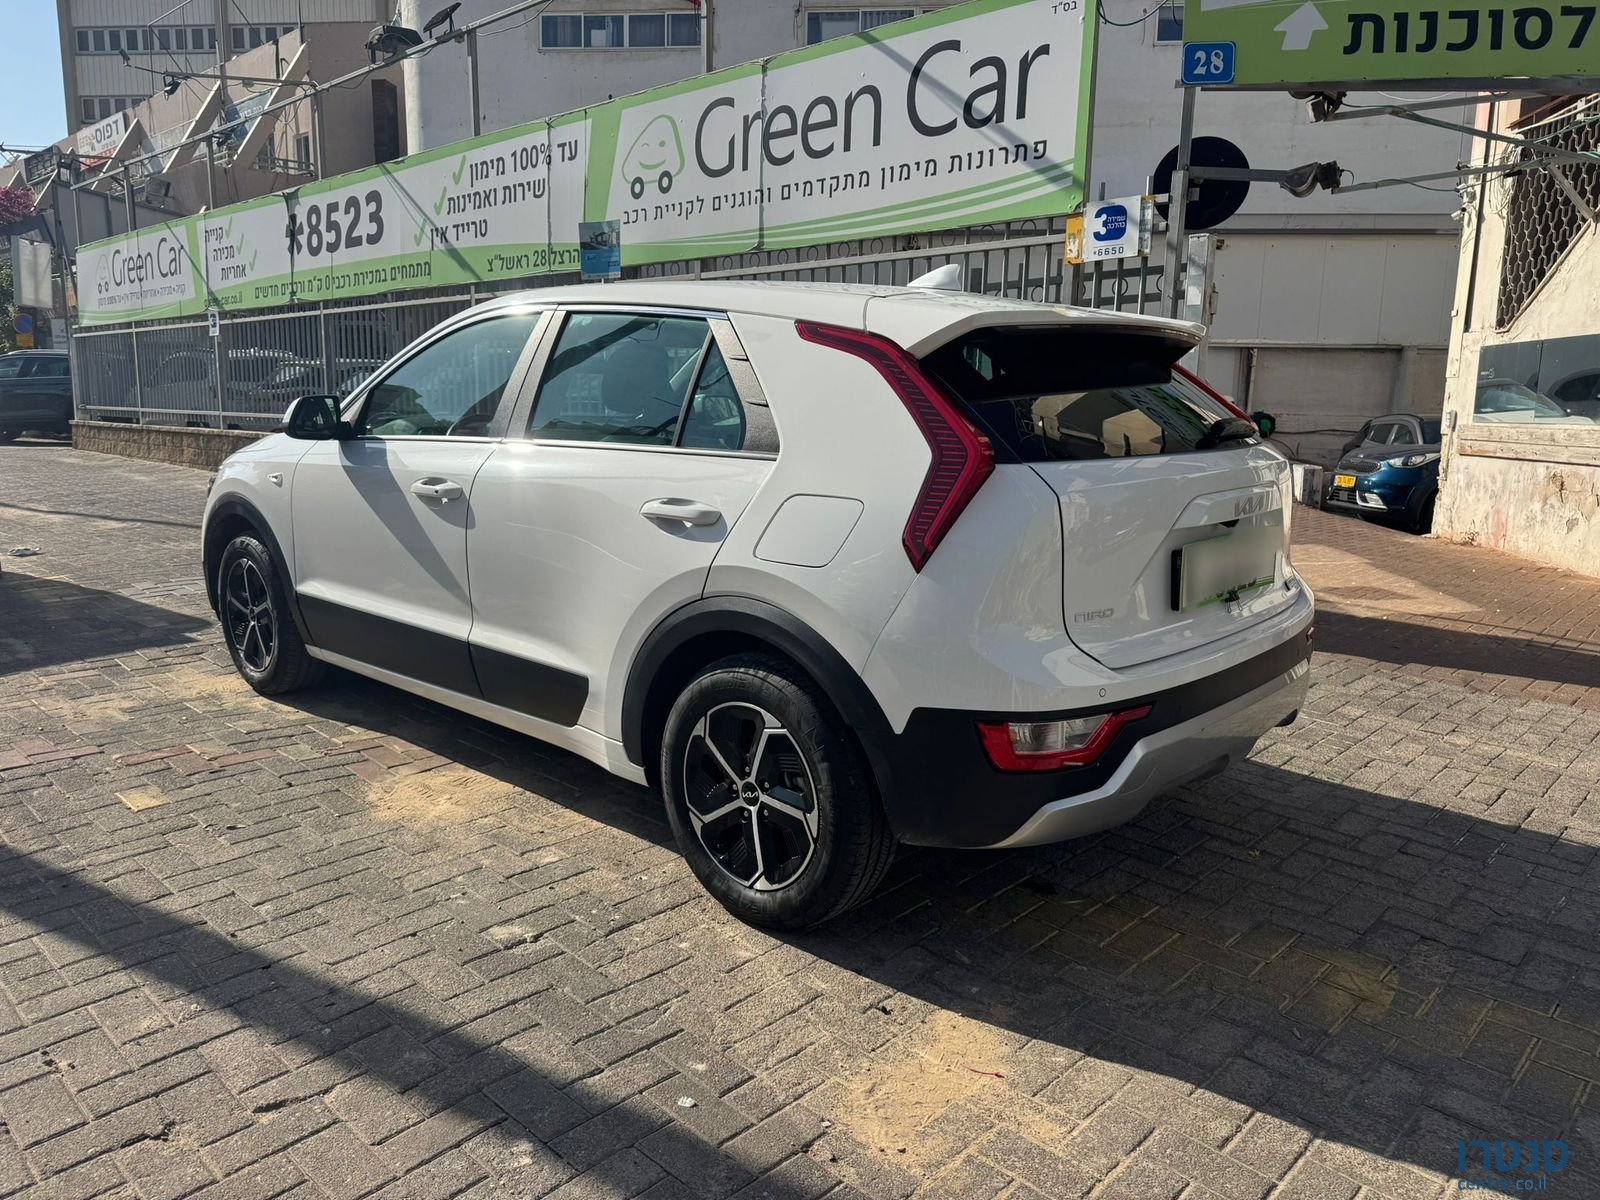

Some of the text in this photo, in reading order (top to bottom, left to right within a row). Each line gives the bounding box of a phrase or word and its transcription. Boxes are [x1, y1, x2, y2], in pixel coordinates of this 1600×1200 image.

[1343, 6, 1597, 55] לסוכנות
[1193, 50, 1225, 75] 28
[695, 40, 1050, 178] Green Car
[95, 119, 120, 144] דפוס
[469, 139, 578, 188] עד 100% מימון
[623, 140, 1048, 225] פתרונות מימון מתקדמים והוגנים לקניית רכב
[447, 178, 546, 215] שירות ואמינות
[430, 218, 488, 251] טרייד אין
[112, 237, 183, 287] Green Car
[213, 245, 235, 262] מכירה
[533, 249, 547, 267] 28
[551, 246, 580, 266] הרצל
[221, 263, 247, 281] אחריות
[332, 274, 350, 290] רכבי
[353, 268, 387, 288] במכירת
[390, 261, 431, 281] מתמחים
[254, 282, 278, 300] חדשים
